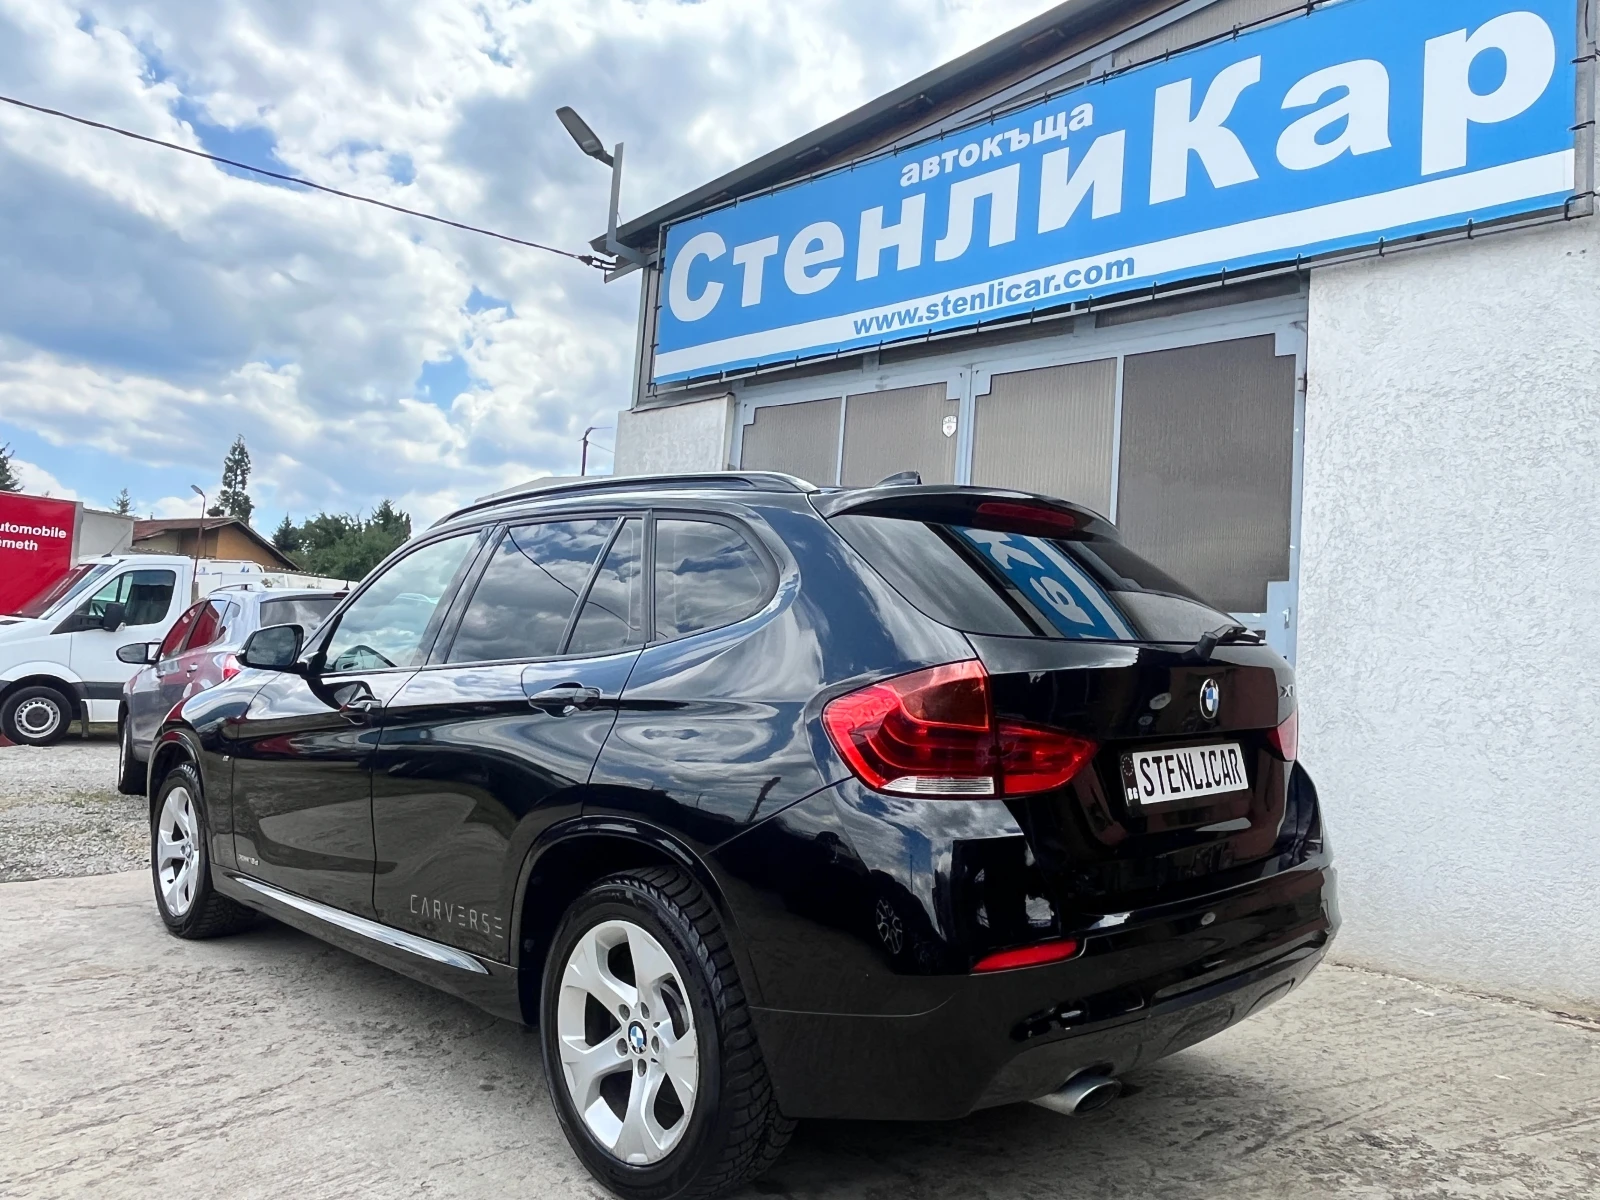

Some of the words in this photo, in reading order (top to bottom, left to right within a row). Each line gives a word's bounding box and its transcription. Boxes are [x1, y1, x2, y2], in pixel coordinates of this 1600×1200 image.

[668, 11, 1556, 322] СтенлиКар
[900, 102, 1094, 188] автокъща
[853, 256, 1136, 336] www.stenlicar.com
[0, 536, 38, 551] meth
[1139, 748, 1243, 797] STENLICAR
[410, 894, 504, 939] CARVERSE
